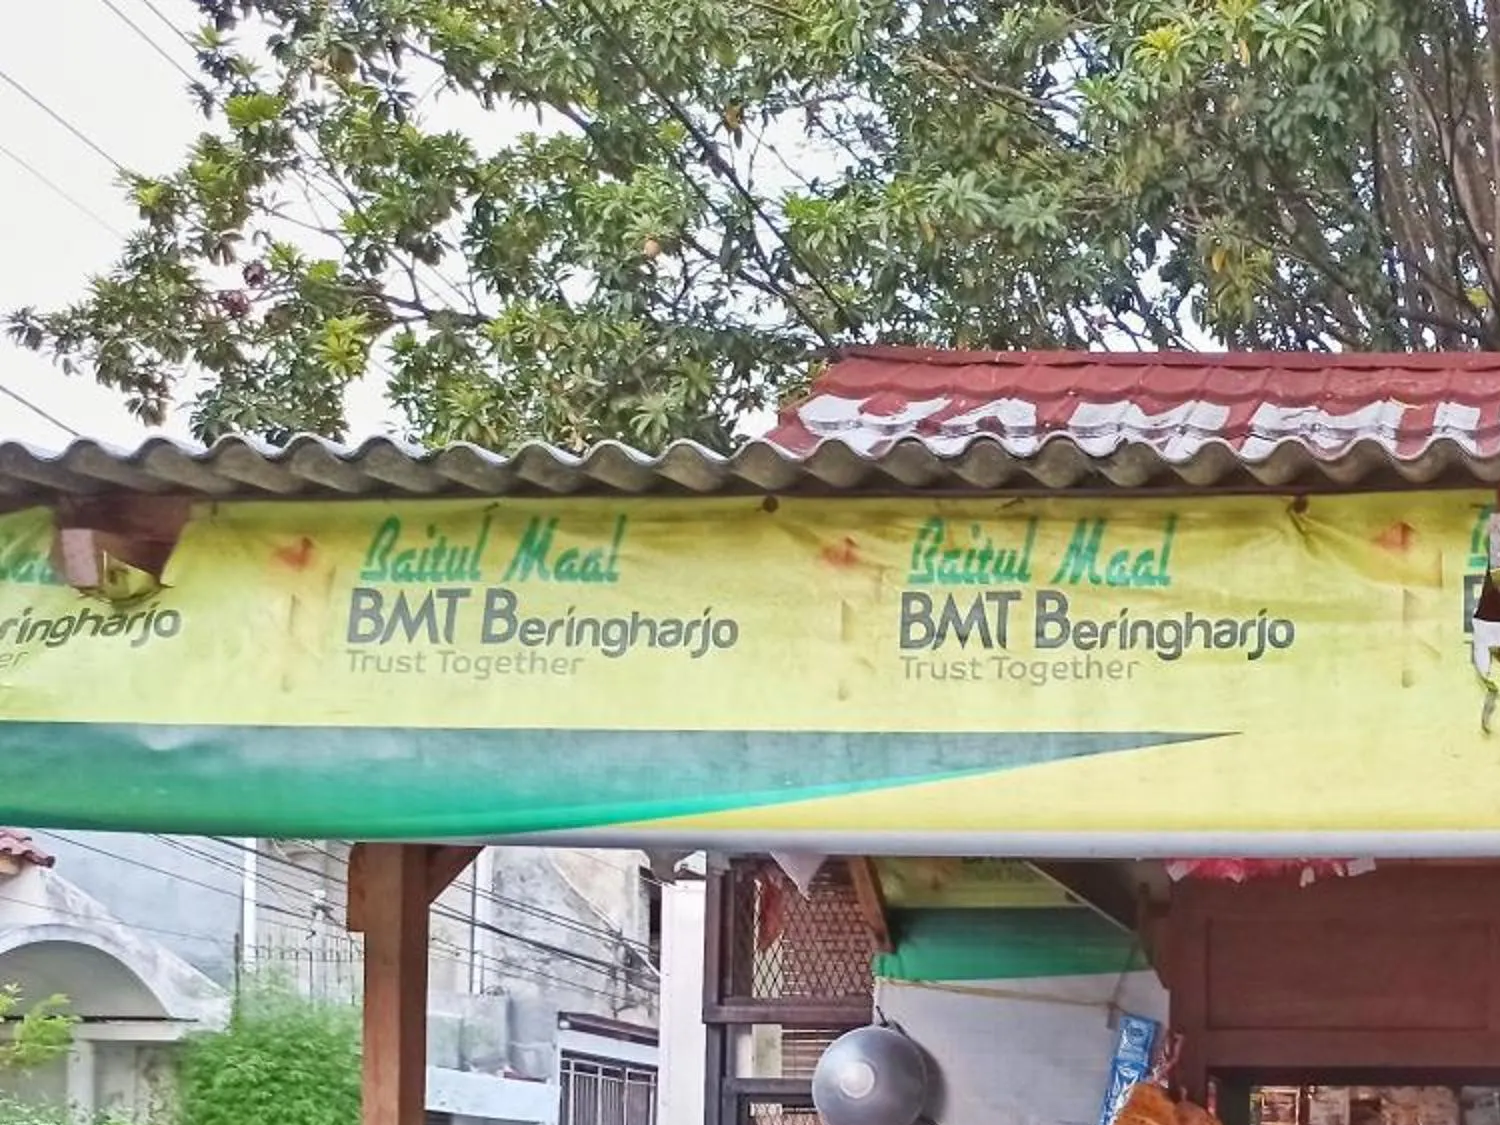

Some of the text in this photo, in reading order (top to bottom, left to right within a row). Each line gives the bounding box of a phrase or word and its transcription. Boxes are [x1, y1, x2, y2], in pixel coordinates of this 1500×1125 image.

[360, 513, 627, 582] Baitul Maal
[907, 515, 1178, 586] Baitul Maal
[0, 602, 181, 648] ringharjo
[346, 587, 739, 658] BMT Beringharjo
[900, 590, 1295, 661] BMT Beringharjo
[346, 648, 584, 681] Trust Together
[900, 655, 1140, 686] Trust Together
